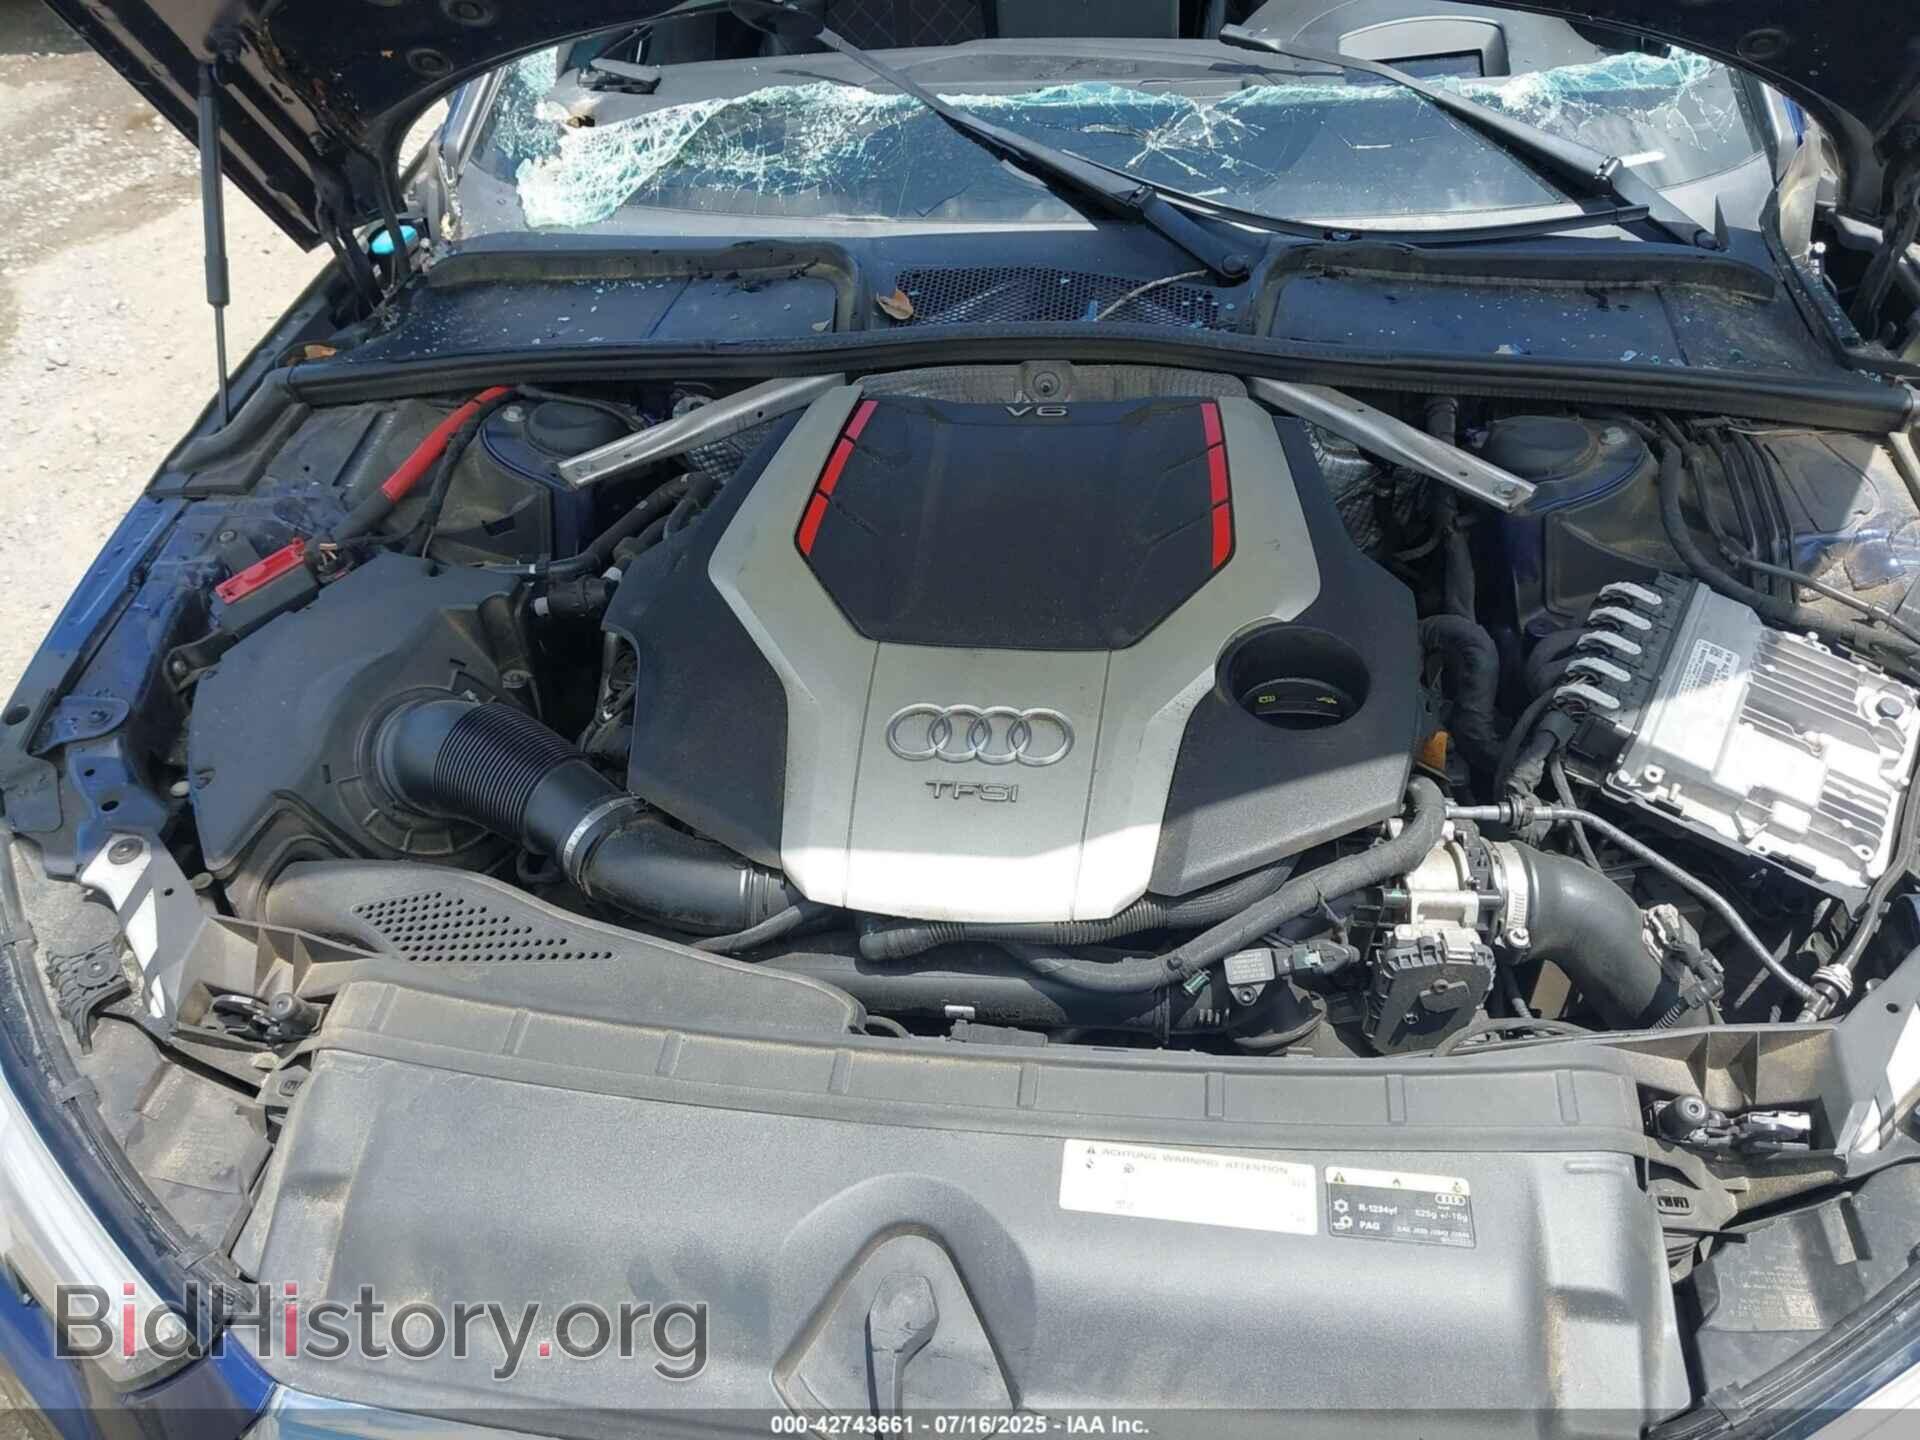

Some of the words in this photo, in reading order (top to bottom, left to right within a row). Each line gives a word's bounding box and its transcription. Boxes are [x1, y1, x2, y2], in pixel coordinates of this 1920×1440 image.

[1005, 405, 1068, 417] V6
[925, 781, 1019, 803] TFSI
[1101, 1147, 1157, 1162] ACHTUNG
[1224, 1161, 1289, 1176] ATTENTION
[1359, 1220, 1380, 1231] PAG
